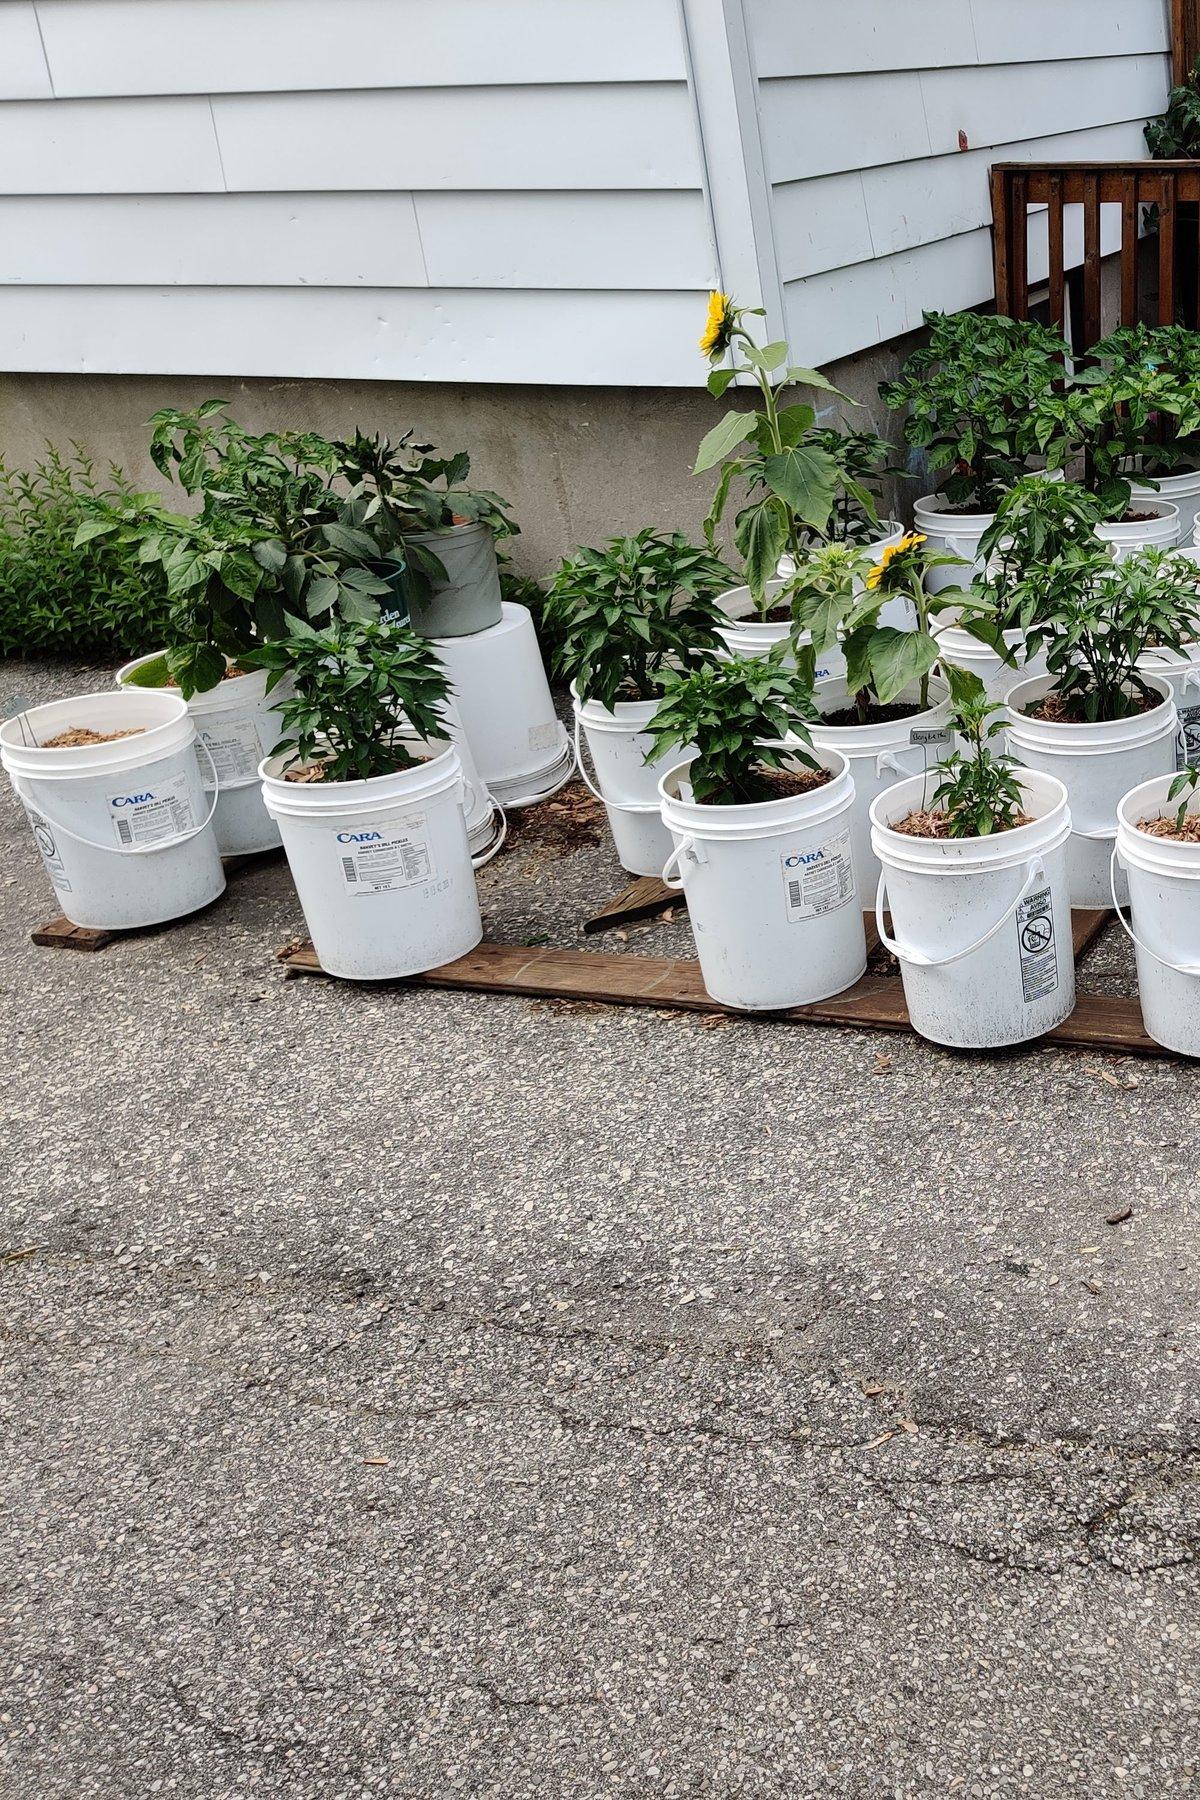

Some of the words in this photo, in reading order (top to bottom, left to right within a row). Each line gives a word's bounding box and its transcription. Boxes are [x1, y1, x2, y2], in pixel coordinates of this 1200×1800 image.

[112, 792, 156, 808] CARA
[336, 831, 383, 844] CARA
[785, 851, 825, 868] CARA
